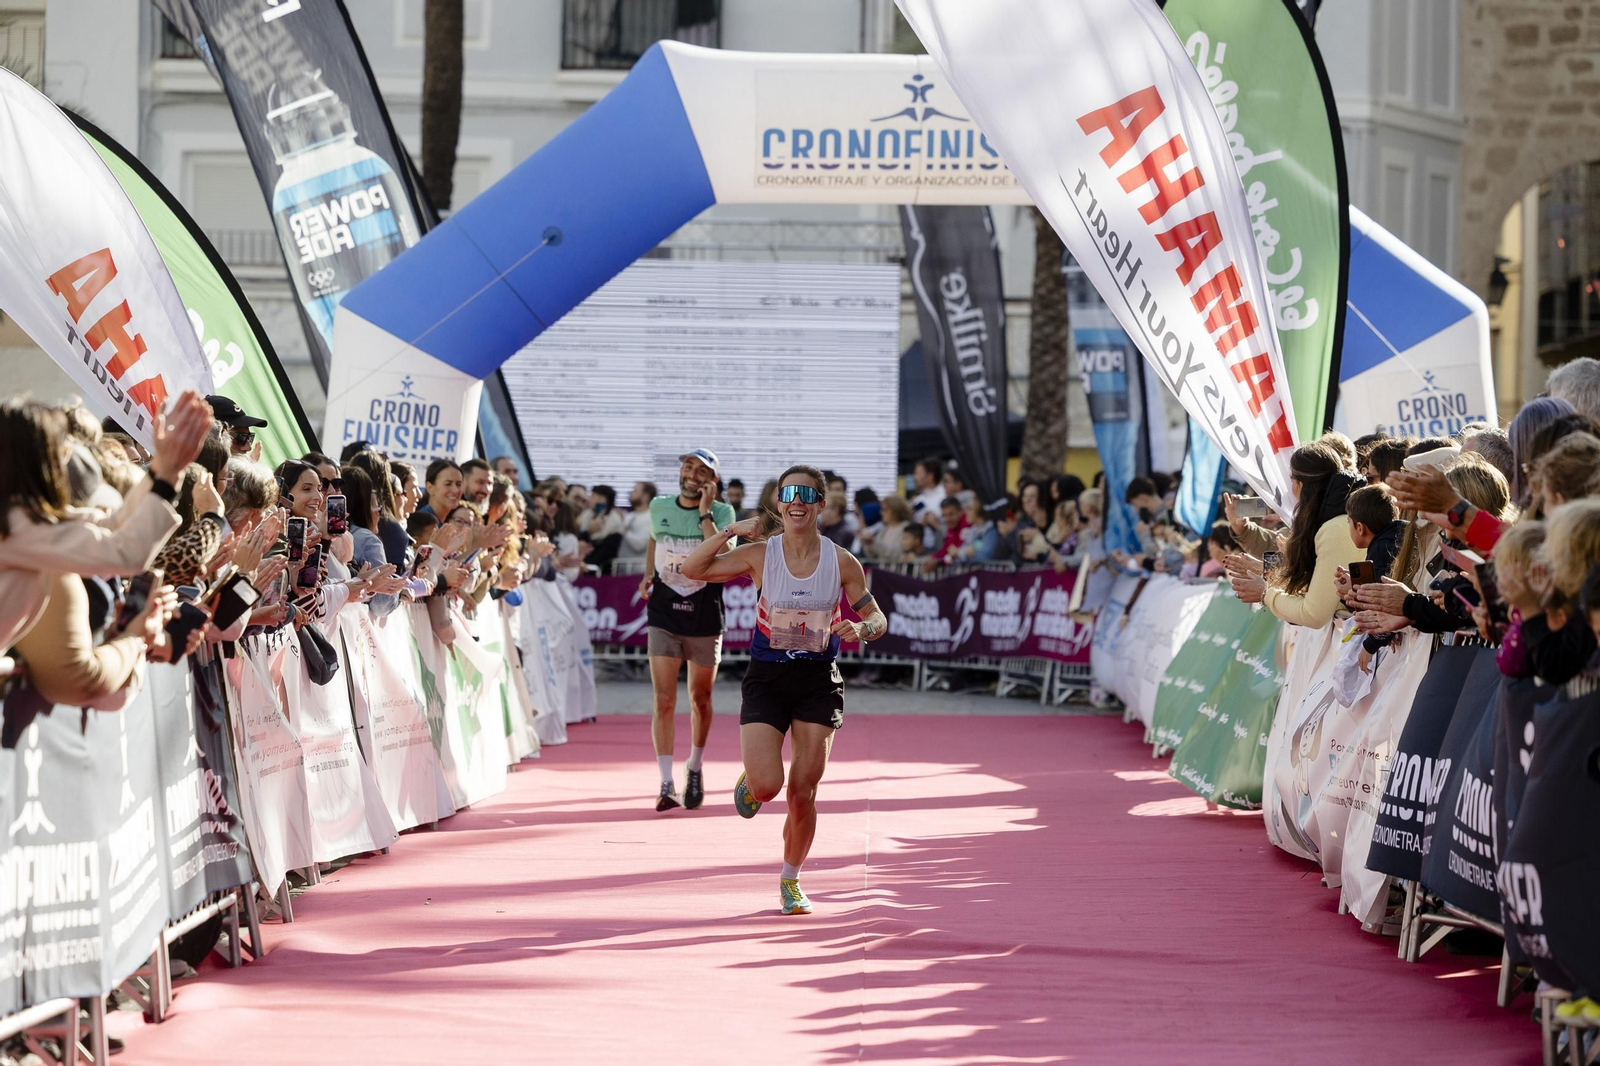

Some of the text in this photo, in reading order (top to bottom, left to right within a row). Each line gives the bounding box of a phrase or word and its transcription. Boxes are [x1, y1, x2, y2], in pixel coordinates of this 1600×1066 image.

[762, 128, 1009, 170] CRONOFINIS
[757, 174, 868, 187] CRONOMETRAJE
[872, 175, 882, 186] Y
[885, 172, 988, 187] ORGANIZACIÓN
[369, 398, 440, 427] CRONO
[1397, 392, 1467, 422] CRONO
[798, 622, 806, 636] 1
[1452, 767, 1499, 866] CRON
